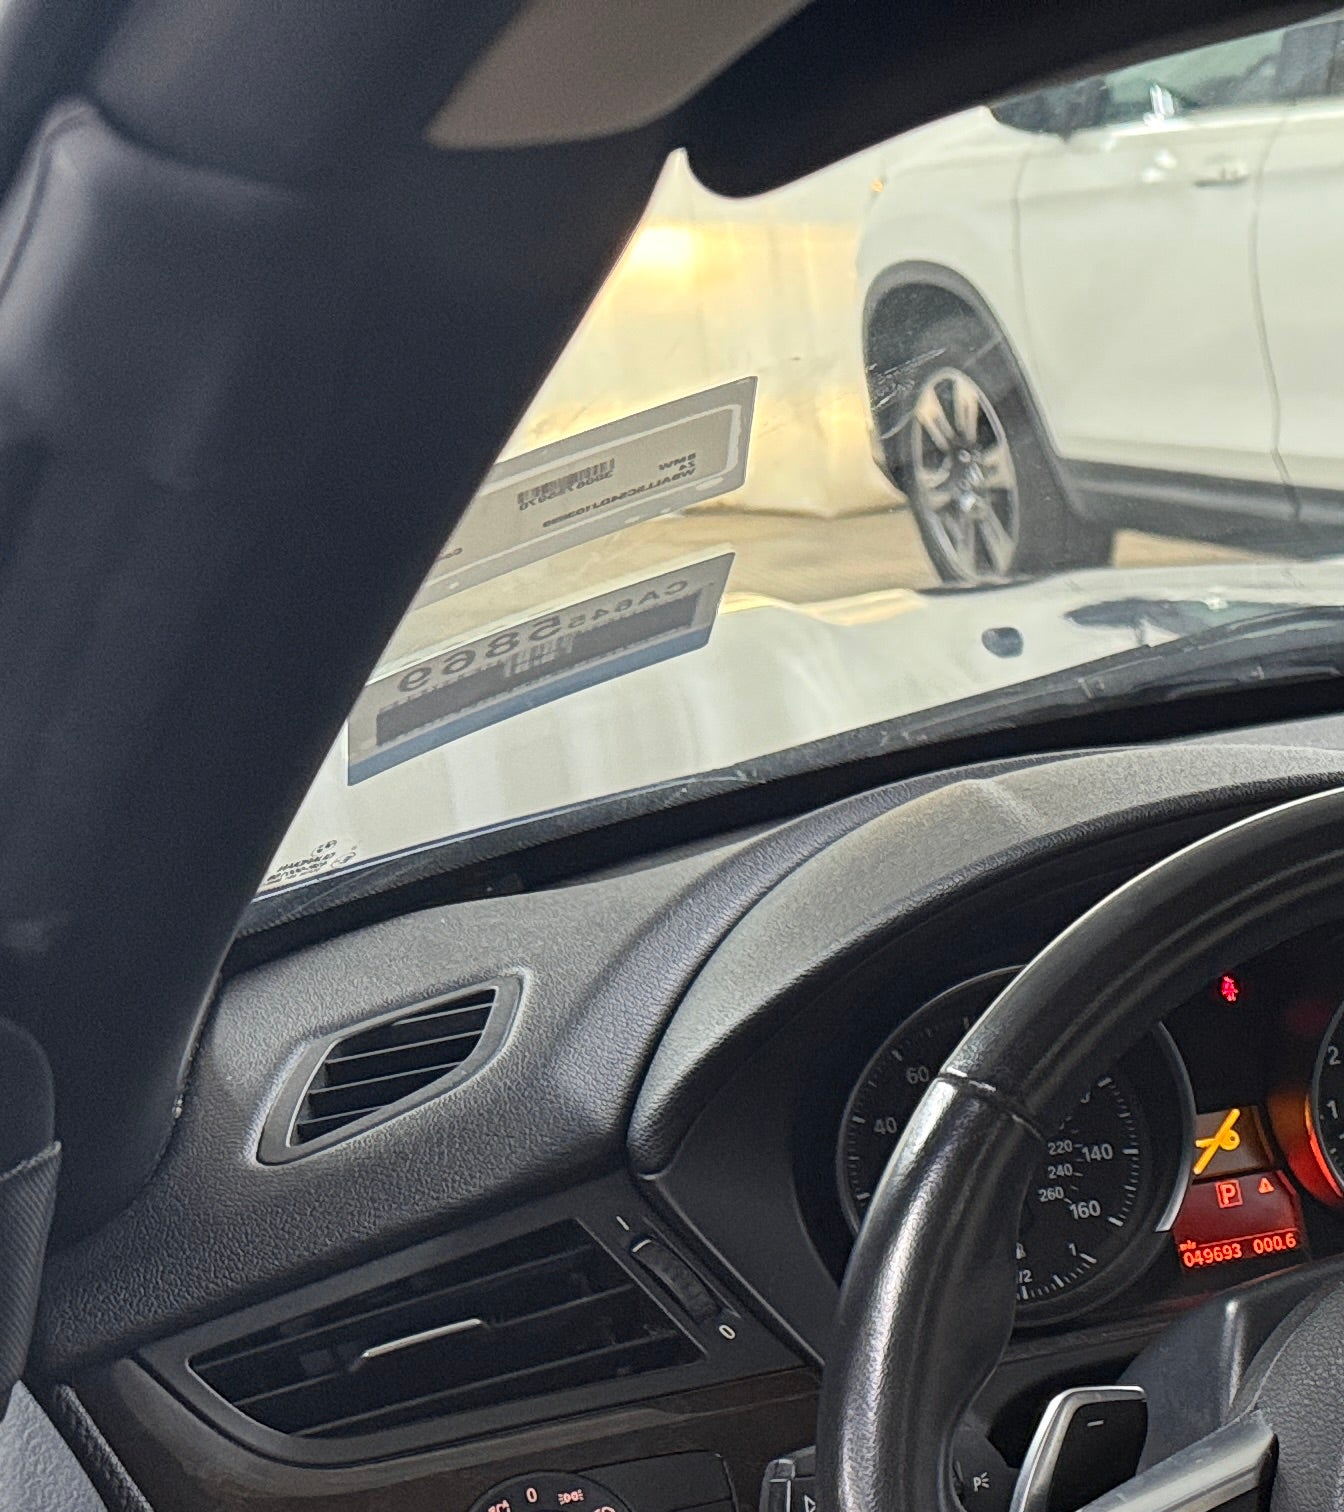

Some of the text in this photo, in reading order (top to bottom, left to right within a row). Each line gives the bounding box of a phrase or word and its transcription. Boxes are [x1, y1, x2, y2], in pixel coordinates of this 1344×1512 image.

[1327, 1046, 1341, 1065] 2
[905, 1067, 930, 1085] 60
[1327, 1100, 1339, 1119] 1
[873, 1117, 897, 1134] 40
[1048, 1139, 1073, 1155] 220
[1081, 1143, 1113, 1162] 140
[1048, 1163, 1073, 1179] 240
[1038, 1186, 1064, 1203] 260
[1070, 1200, 1101, 1220] 160
[1068, 1243, 1078, 1257] 1
[1183, 1233, 1297, 1267] 049693 000.6
